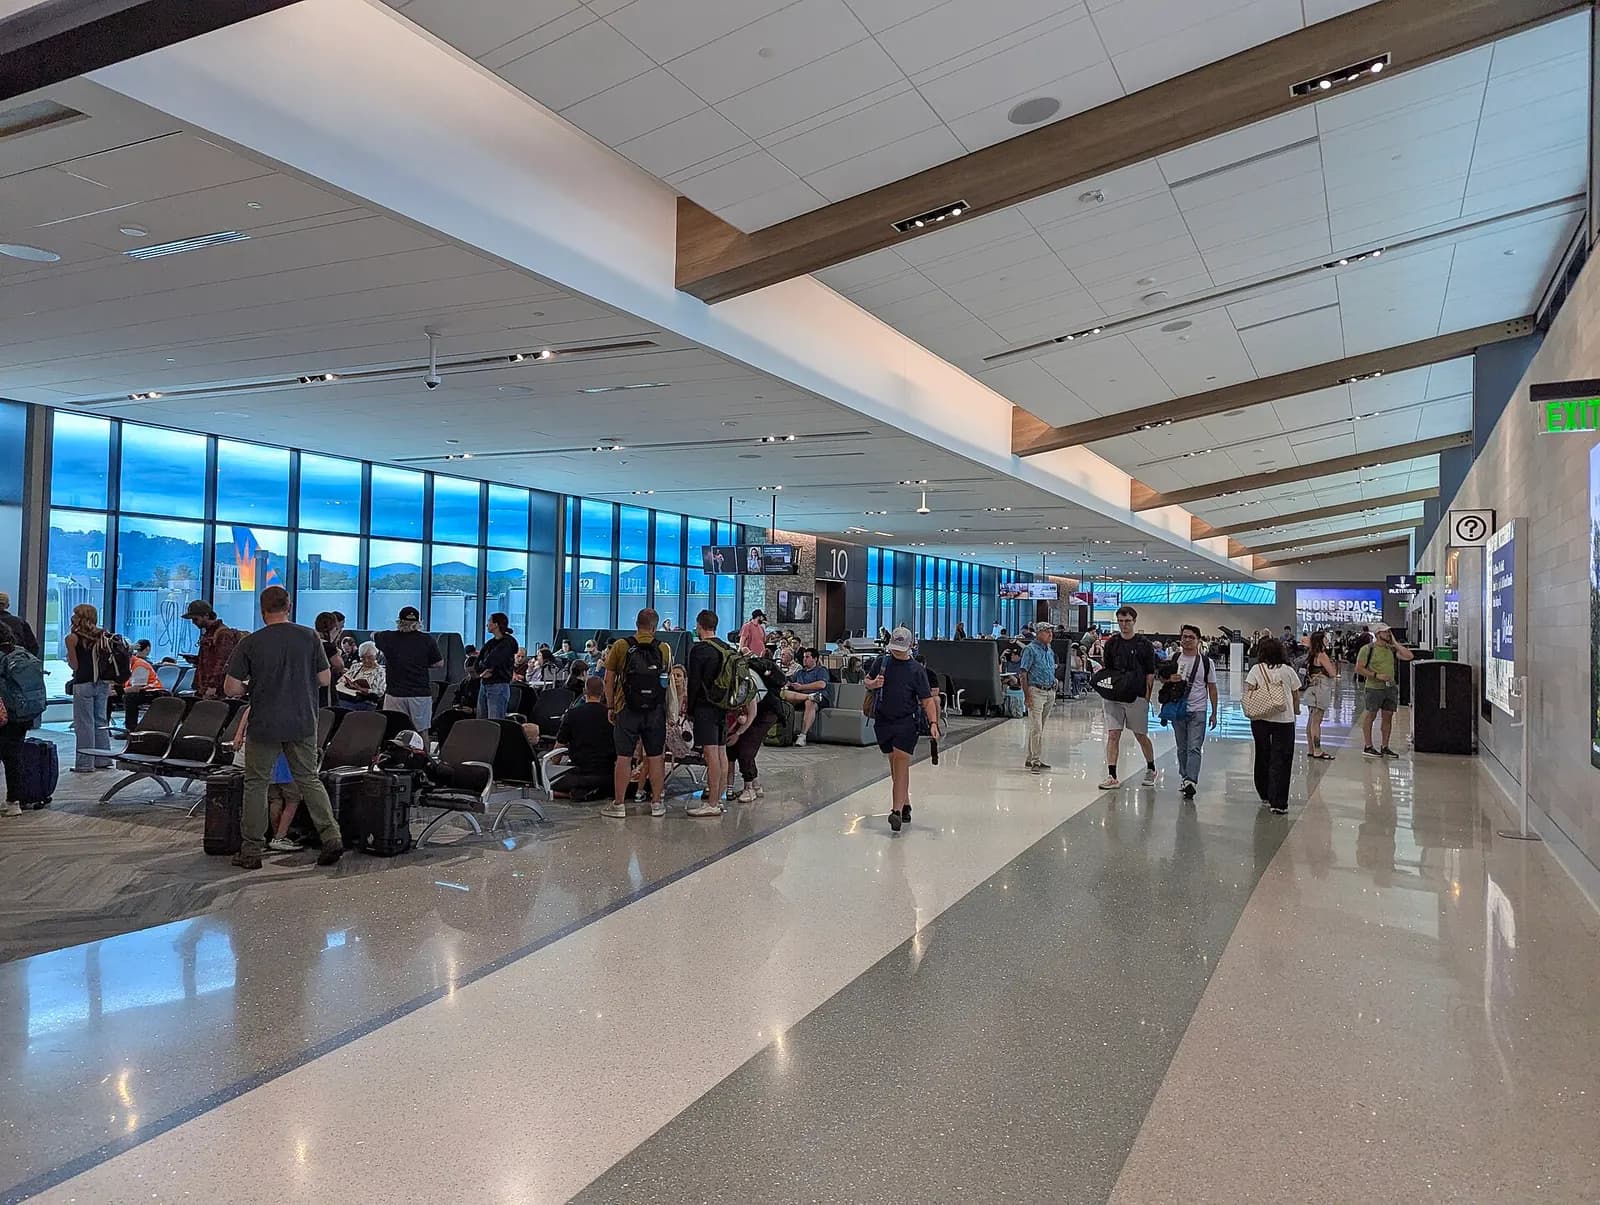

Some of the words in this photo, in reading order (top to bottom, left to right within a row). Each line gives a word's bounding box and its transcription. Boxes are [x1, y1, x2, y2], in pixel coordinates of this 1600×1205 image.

[1546, 399, 1600, 432] EXIT
[89, 553, 99, 568] 10
[830, 549, 848, 579] 10
[580, 579, 590, 589] 12
[1302, 599, 1335, 611] MORE
[1338, 599, 1377, 612] SPACE
[1302, 611, 1312, 622] IS
[1314, 611, 1328, 622] ON
[1302, 622, 1314, 632] AT
